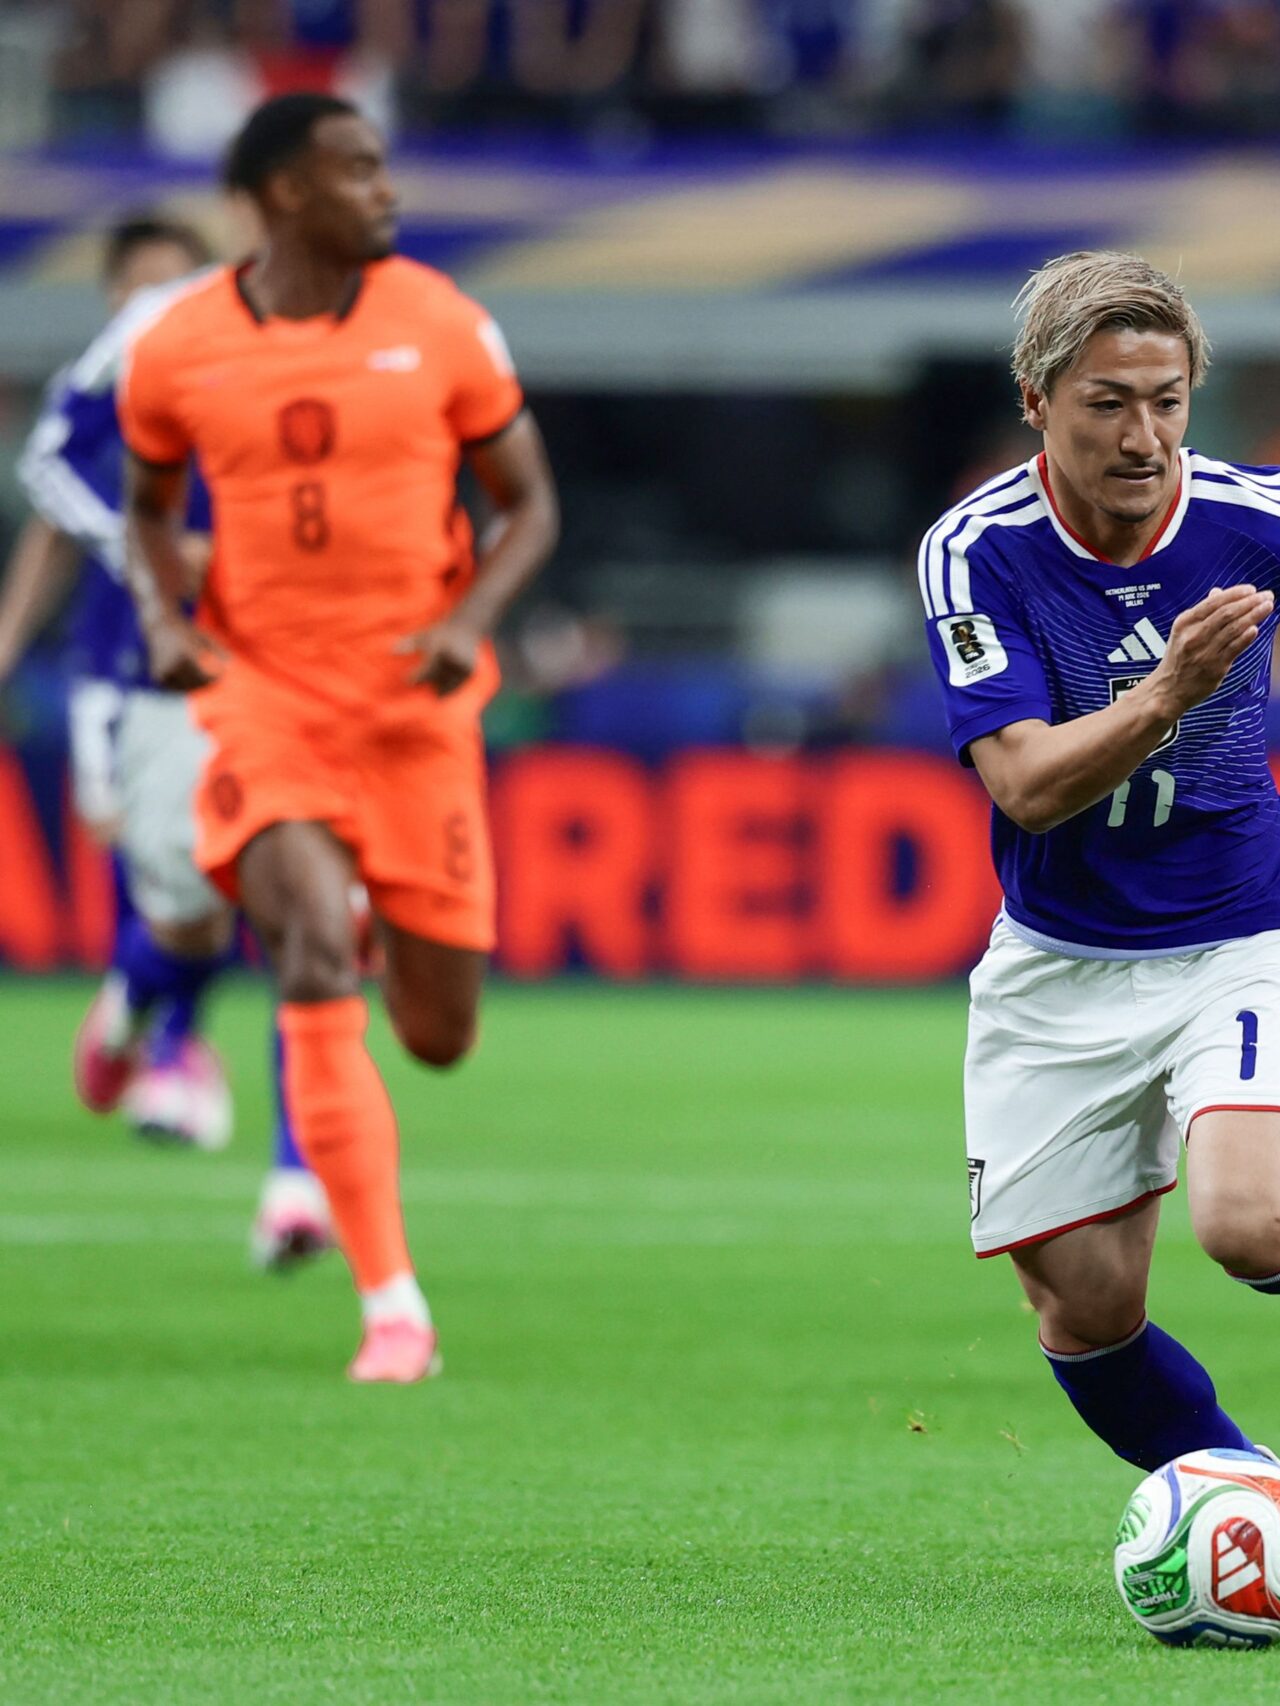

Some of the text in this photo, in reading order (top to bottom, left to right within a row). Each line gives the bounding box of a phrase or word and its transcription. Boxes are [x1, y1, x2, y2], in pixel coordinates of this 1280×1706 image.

[290, 478, 331, 553] 8
[965, 664, 990, 678] 2026
[1107, 769, 1175, 828] 11
